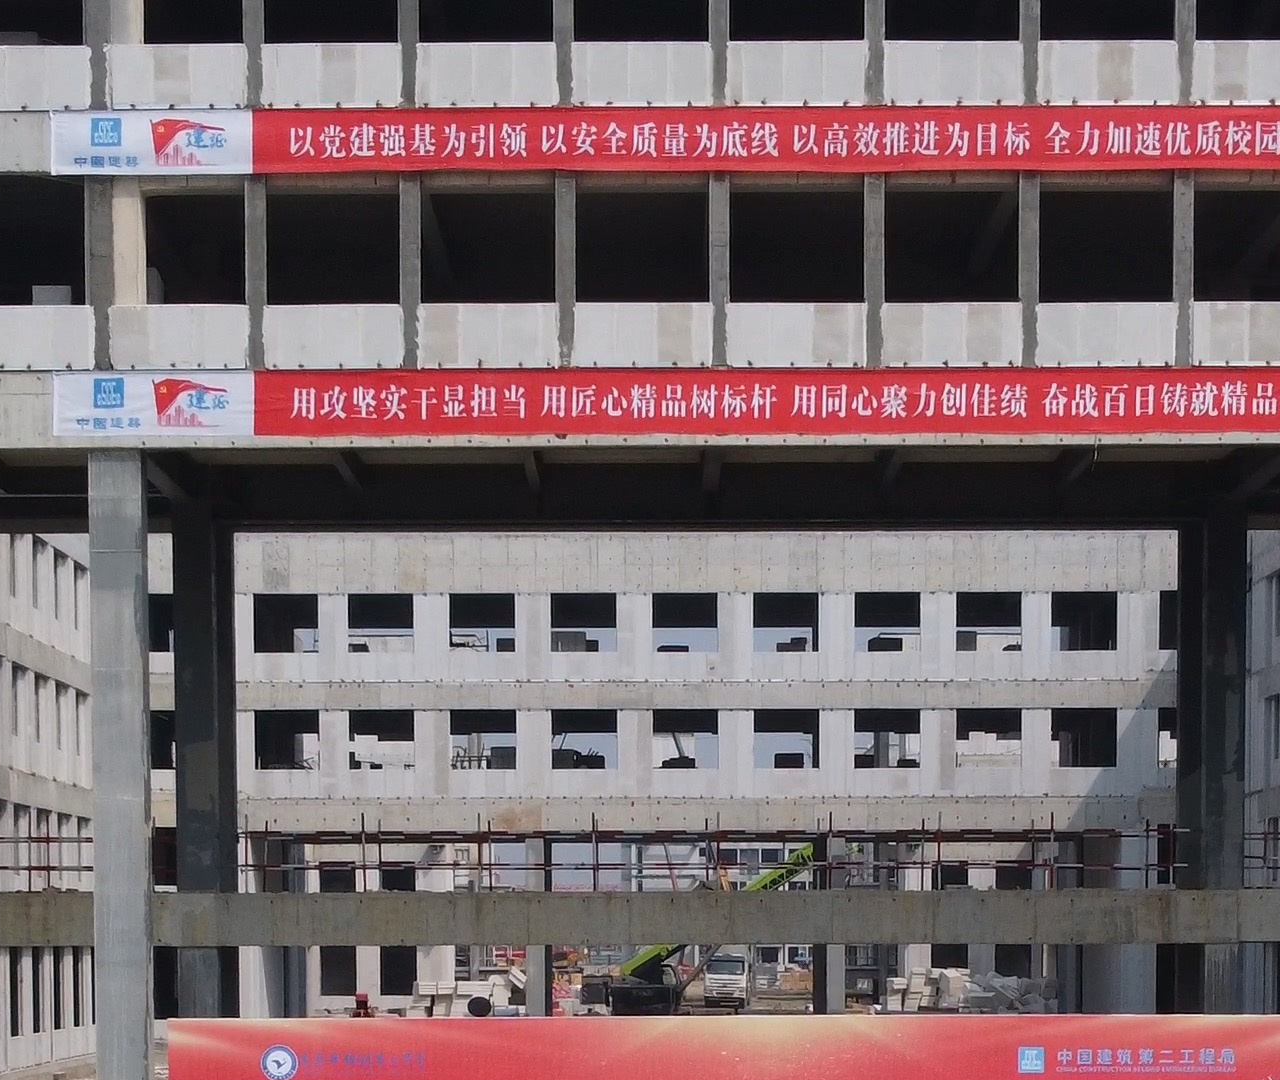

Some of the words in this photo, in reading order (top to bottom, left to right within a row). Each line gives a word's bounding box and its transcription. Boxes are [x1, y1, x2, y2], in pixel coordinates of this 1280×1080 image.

[289, 123, 527, 157] 以党建强基为引领
[541, 122, 779, 157] 以安全质量为底线
[792, 121, 1030, 157] 以高效推进为目标
[290, 384, 527, 420] 用攻坚实干显担当
[541, 384, 777, 419] 用匠心精品树标杆
[791, 383, 1028, 419] 用同心聚力创佳绩
